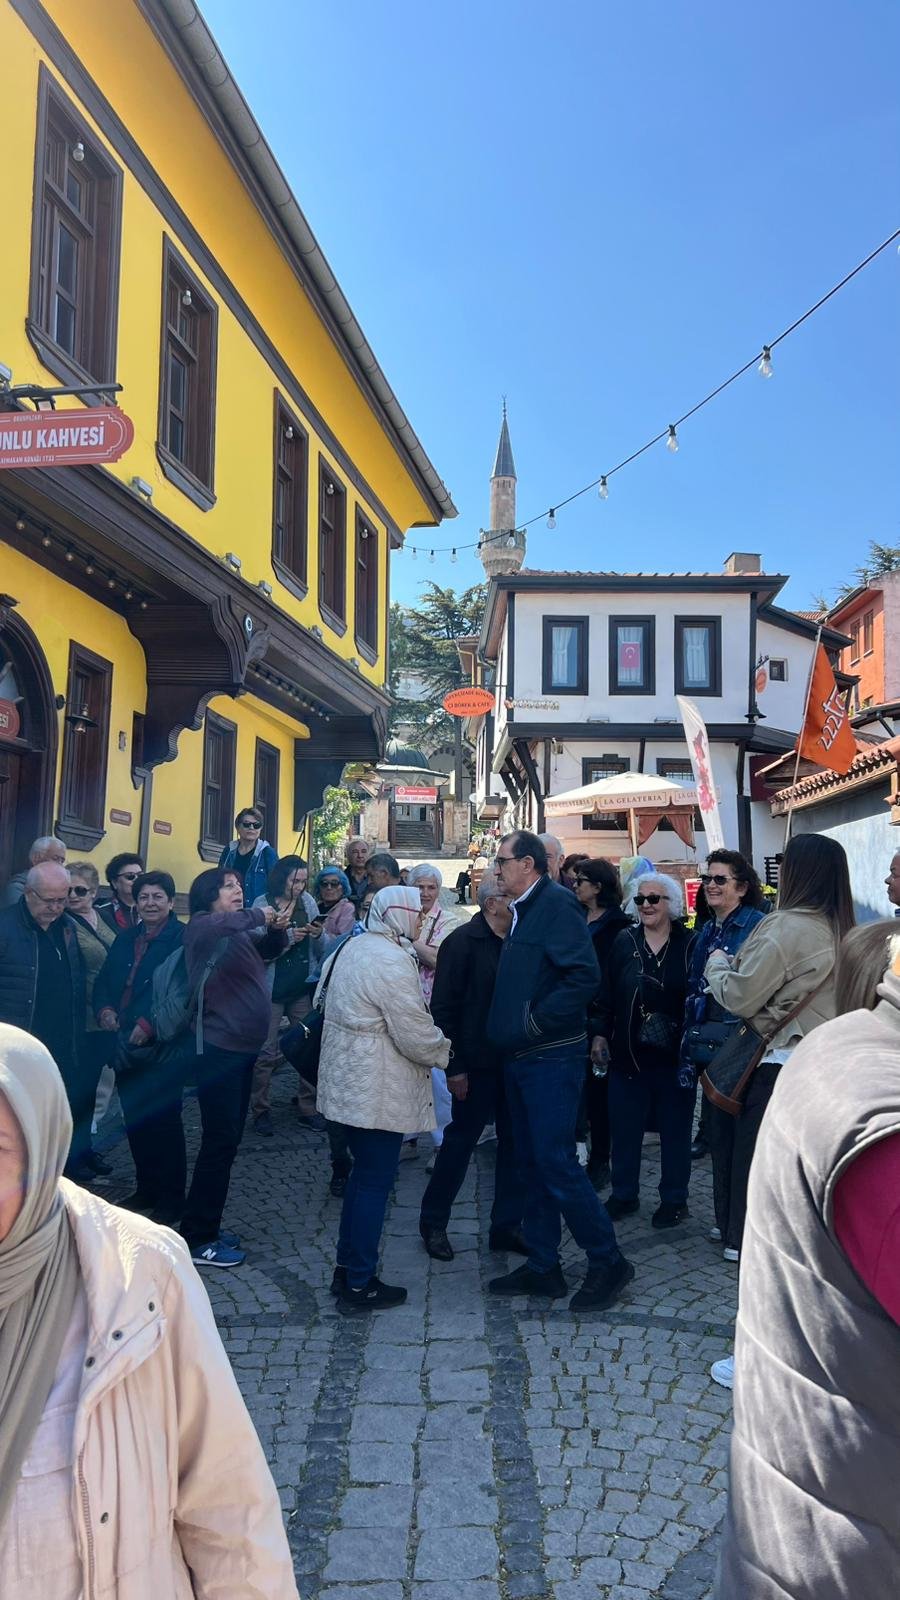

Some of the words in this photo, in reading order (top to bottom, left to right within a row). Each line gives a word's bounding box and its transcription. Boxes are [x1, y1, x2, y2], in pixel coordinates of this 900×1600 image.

[0, 431, 32, 451] NLU
[37, 421, 104, 449] KAHVESİ
[616, 795, 663, 804] GELATERIA
[201, 1247, 217, 1260] N
